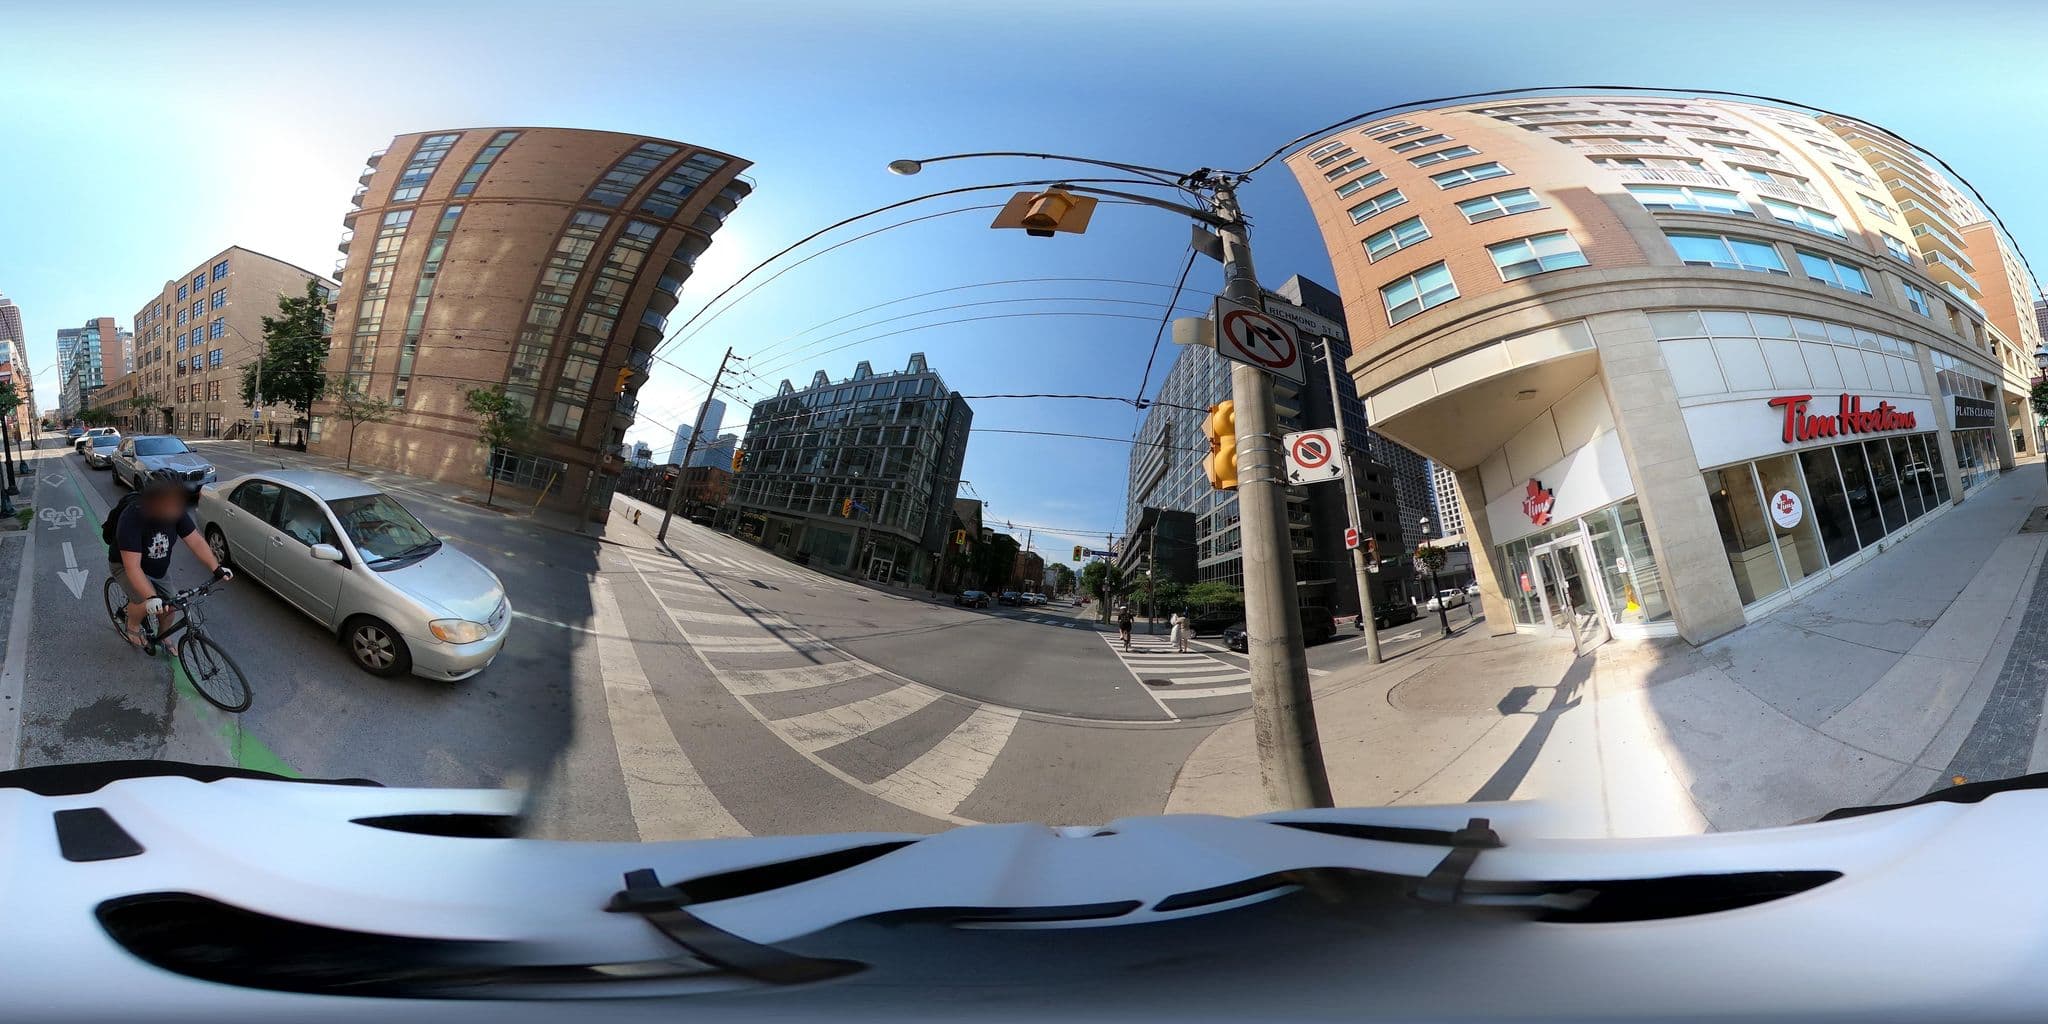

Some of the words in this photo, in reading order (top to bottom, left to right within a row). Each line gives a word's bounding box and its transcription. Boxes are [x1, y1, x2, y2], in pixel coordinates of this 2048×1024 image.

[1269, 306, 1317, 329] RICHMOND
[1767, 395, 1838, 444] Tim
[1837, 392, 1917, 436] Hortons
[1955, 405, 1975, 417] PLATIS
